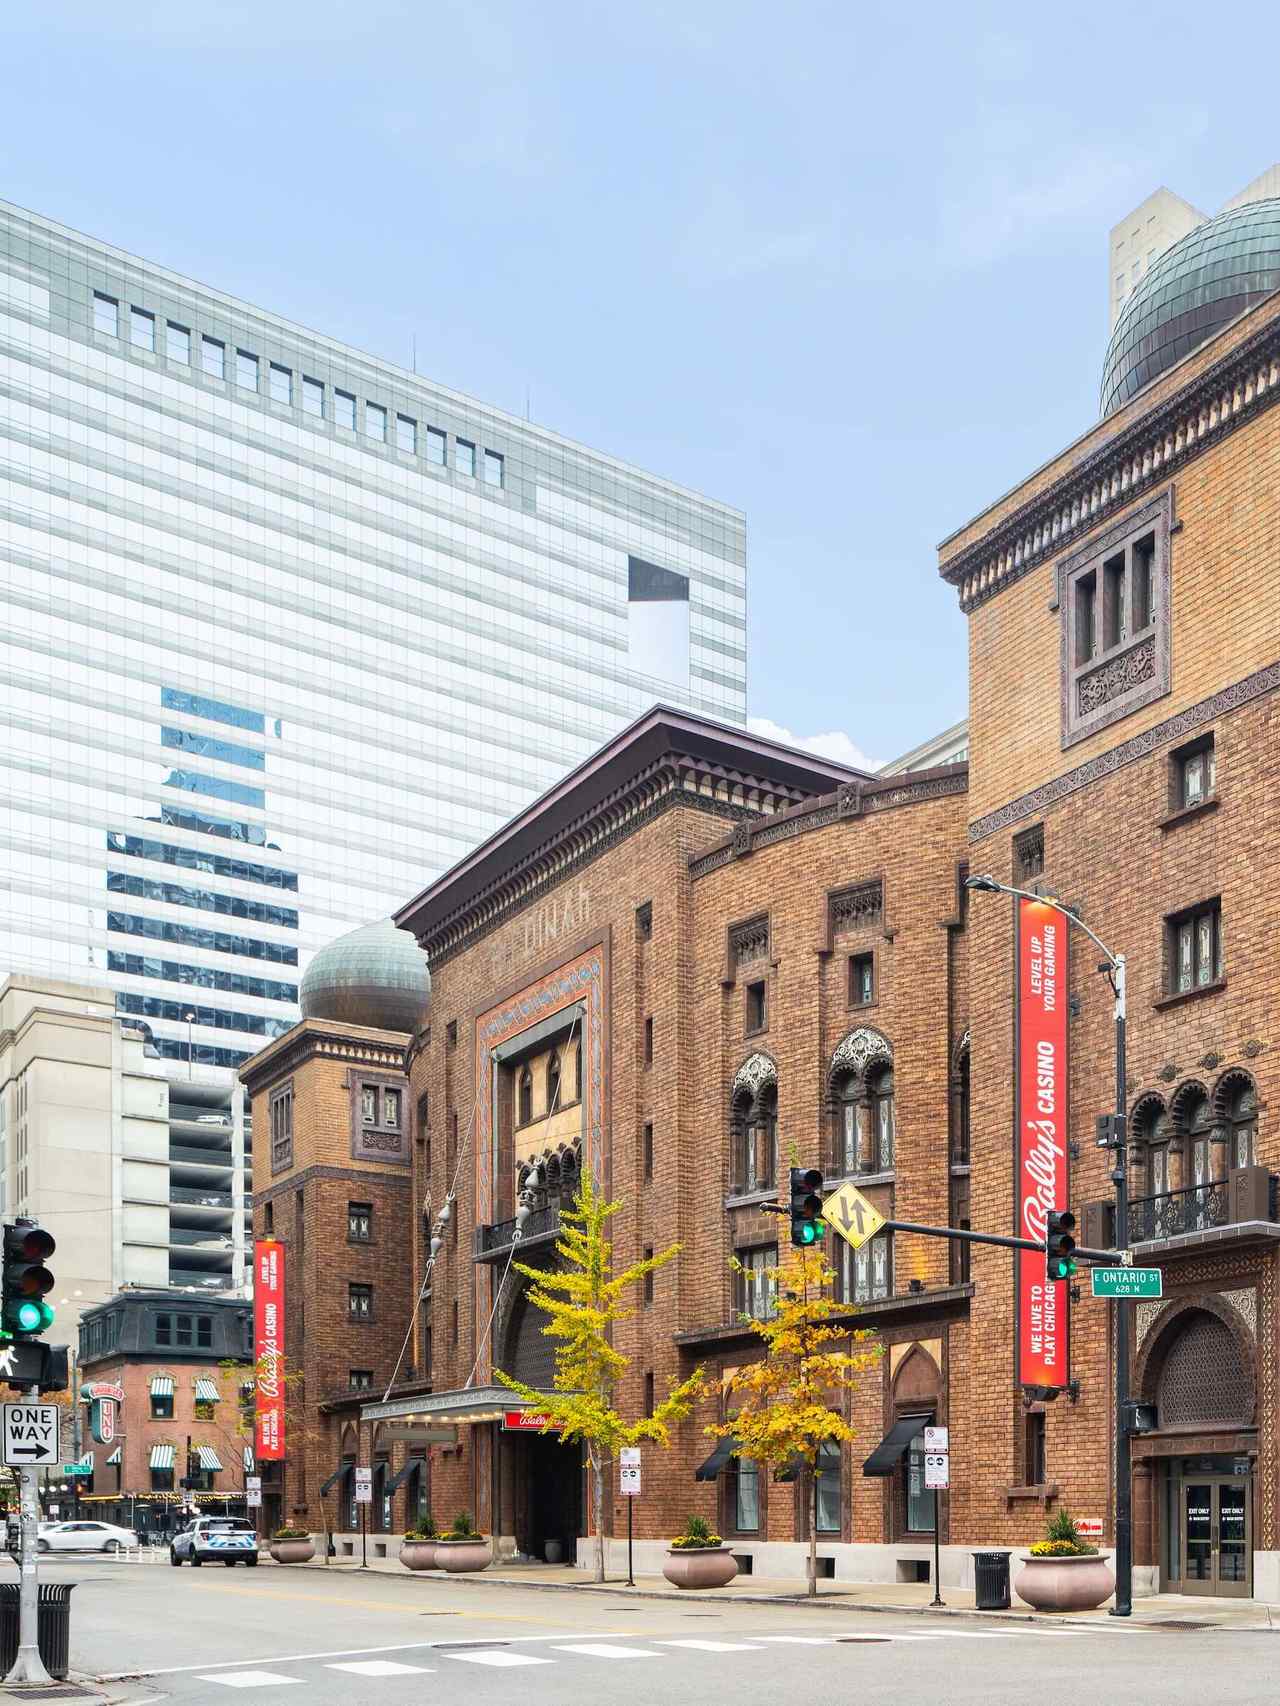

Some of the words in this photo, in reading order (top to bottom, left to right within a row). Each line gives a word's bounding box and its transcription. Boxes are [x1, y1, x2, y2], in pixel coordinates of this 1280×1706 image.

[1030, 936, 1041, 955] UP
[1043, 925, 1056, 977] GAMING
[1031, 957, 1042, 995] LEVEL
[1044, 978, 1055, 1013] YOUR
[1036, 1041, 1055, 1115] CASINO
[1094, 1273, 1100, 1282] E
[1102, 1271, 1147, 1284] ONTARIO
[1149, 1273, 1159, 1282] ST
[1115, 1285, 1130, 1294] 628
[1031, 1285, 1042, 1303] TO
[1044, 1283, 1056, 1333] CHICAG
[264, 1303, 277, 1337] CASINO
[1031, 1304, 1042, 1333] LIVE
[1031, 1334, 1042, 1354] WE
[1044, 1334, 1056, 1366] PLAY
[11, 1408, 52, 1424] ONE
[10, 1425, 52, 1440] WAY
